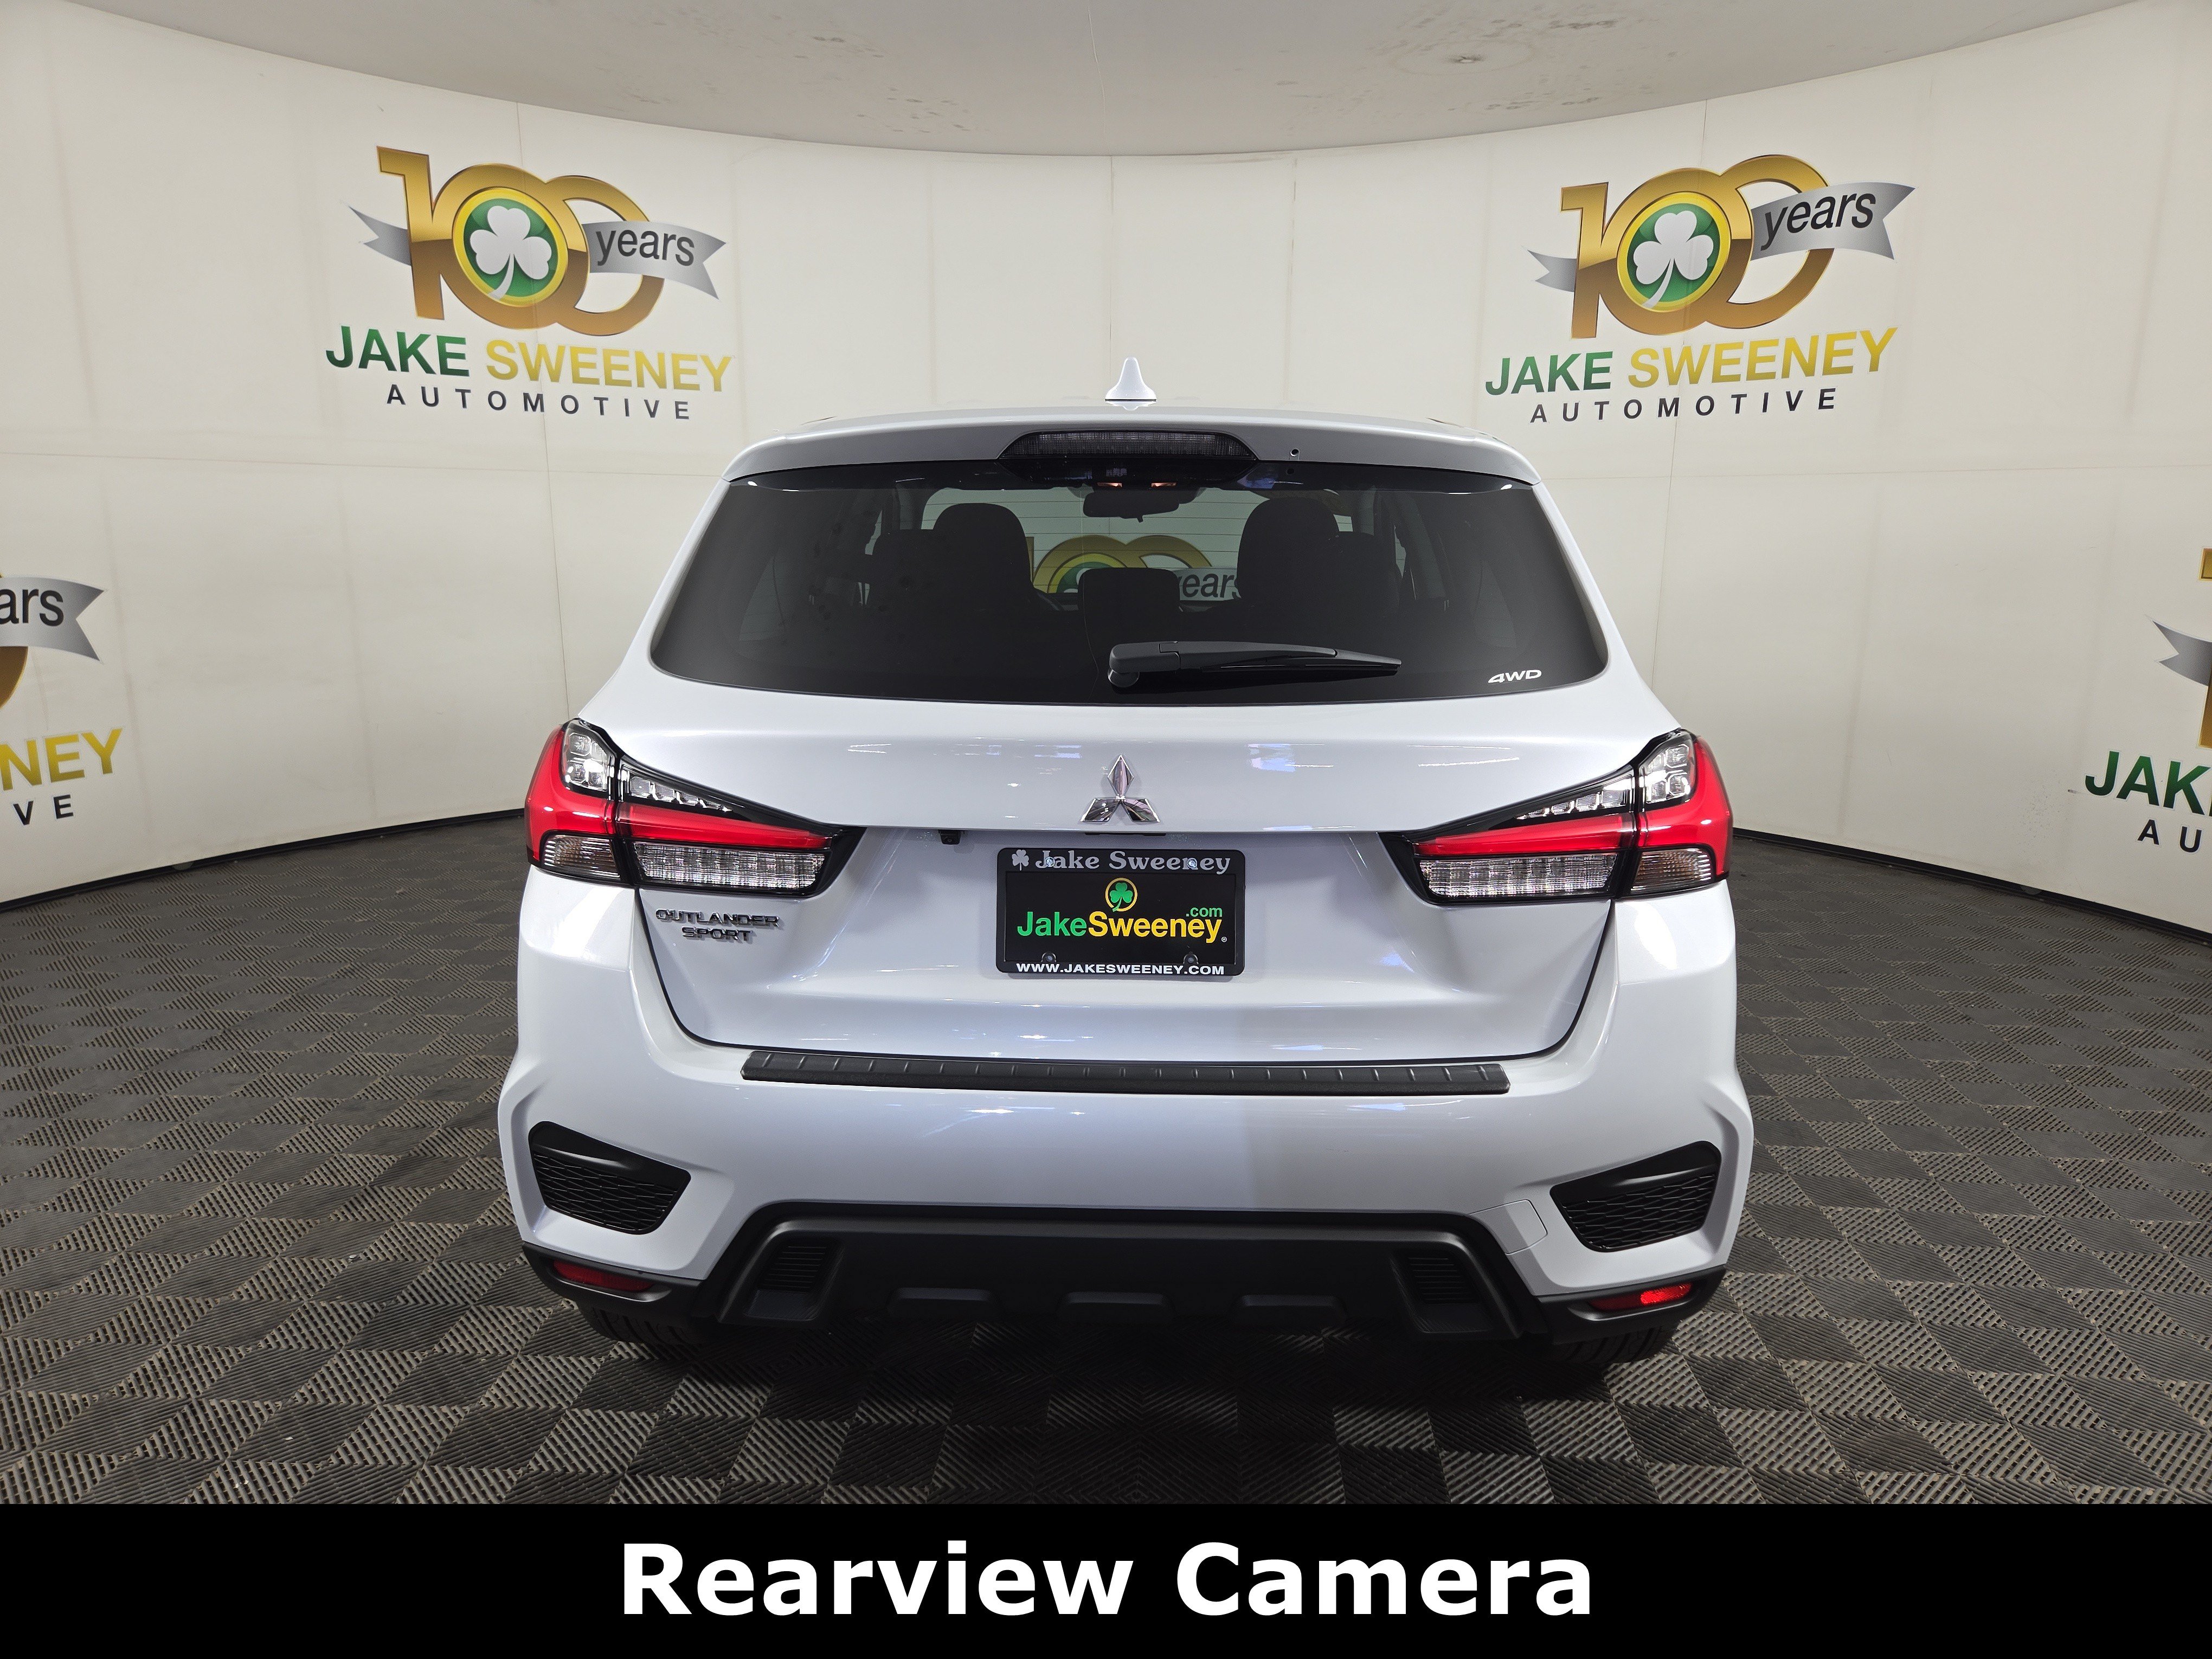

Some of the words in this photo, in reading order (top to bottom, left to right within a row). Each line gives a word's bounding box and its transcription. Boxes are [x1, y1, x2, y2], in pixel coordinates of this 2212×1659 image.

[1760, 192, 1876, 251] years
[595, 229, 695, 266] years
[325, 325, 470, 377] JAKE
[486, 339, 732, 391] SWEENEY
[1485, 351, 1613, 395] JAKE
[1628, 327, 1898, 388] SWEENEY
[387, 384, 690, 420] AUTOMOTIVE
[1530, 388, 1836, 422] AUTOMOTIVE
[1178, 574, 1242, 599] ear
[1488, 670, 1542, 683] 4WD
[2085, 750, 2212, 816] JAK
[1036, 850, 1099, 870] Jake
[1109, 851, 1231, 874] Sweeney
[655, 909, 780, 928] OUTLANDER
[681, 926, 753, 941] SPORT
[1017, 963, 1225, 975] WWW.JAKESWEENEY.COM
